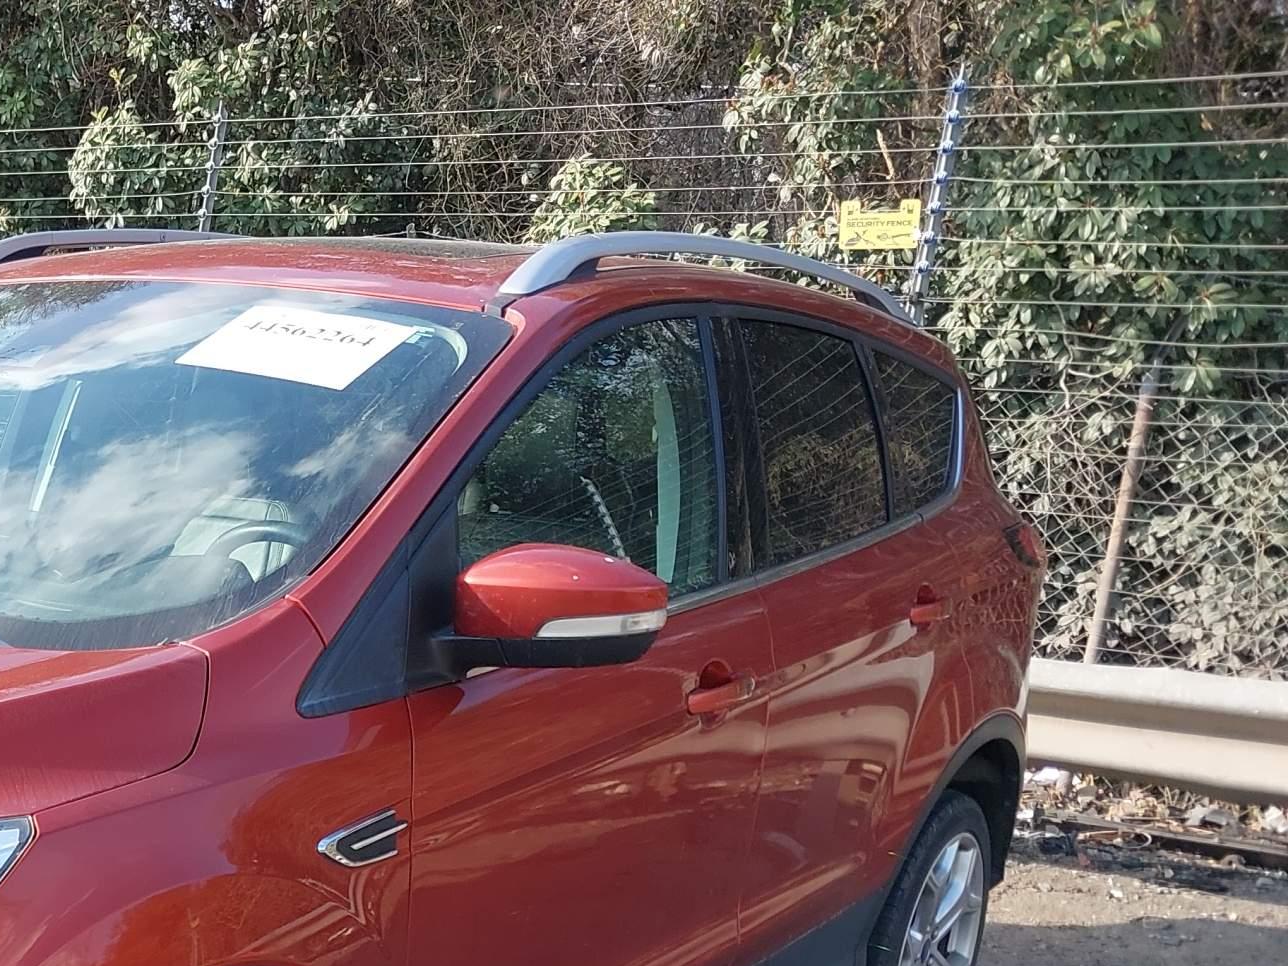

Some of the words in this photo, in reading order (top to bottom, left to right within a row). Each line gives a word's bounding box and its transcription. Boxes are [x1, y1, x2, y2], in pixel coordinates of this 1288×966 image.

[847, 220, 886, 228] SECURITY
[887, 219, 912, 227] FENCE
[244, 320, 375, 347] 44562264
